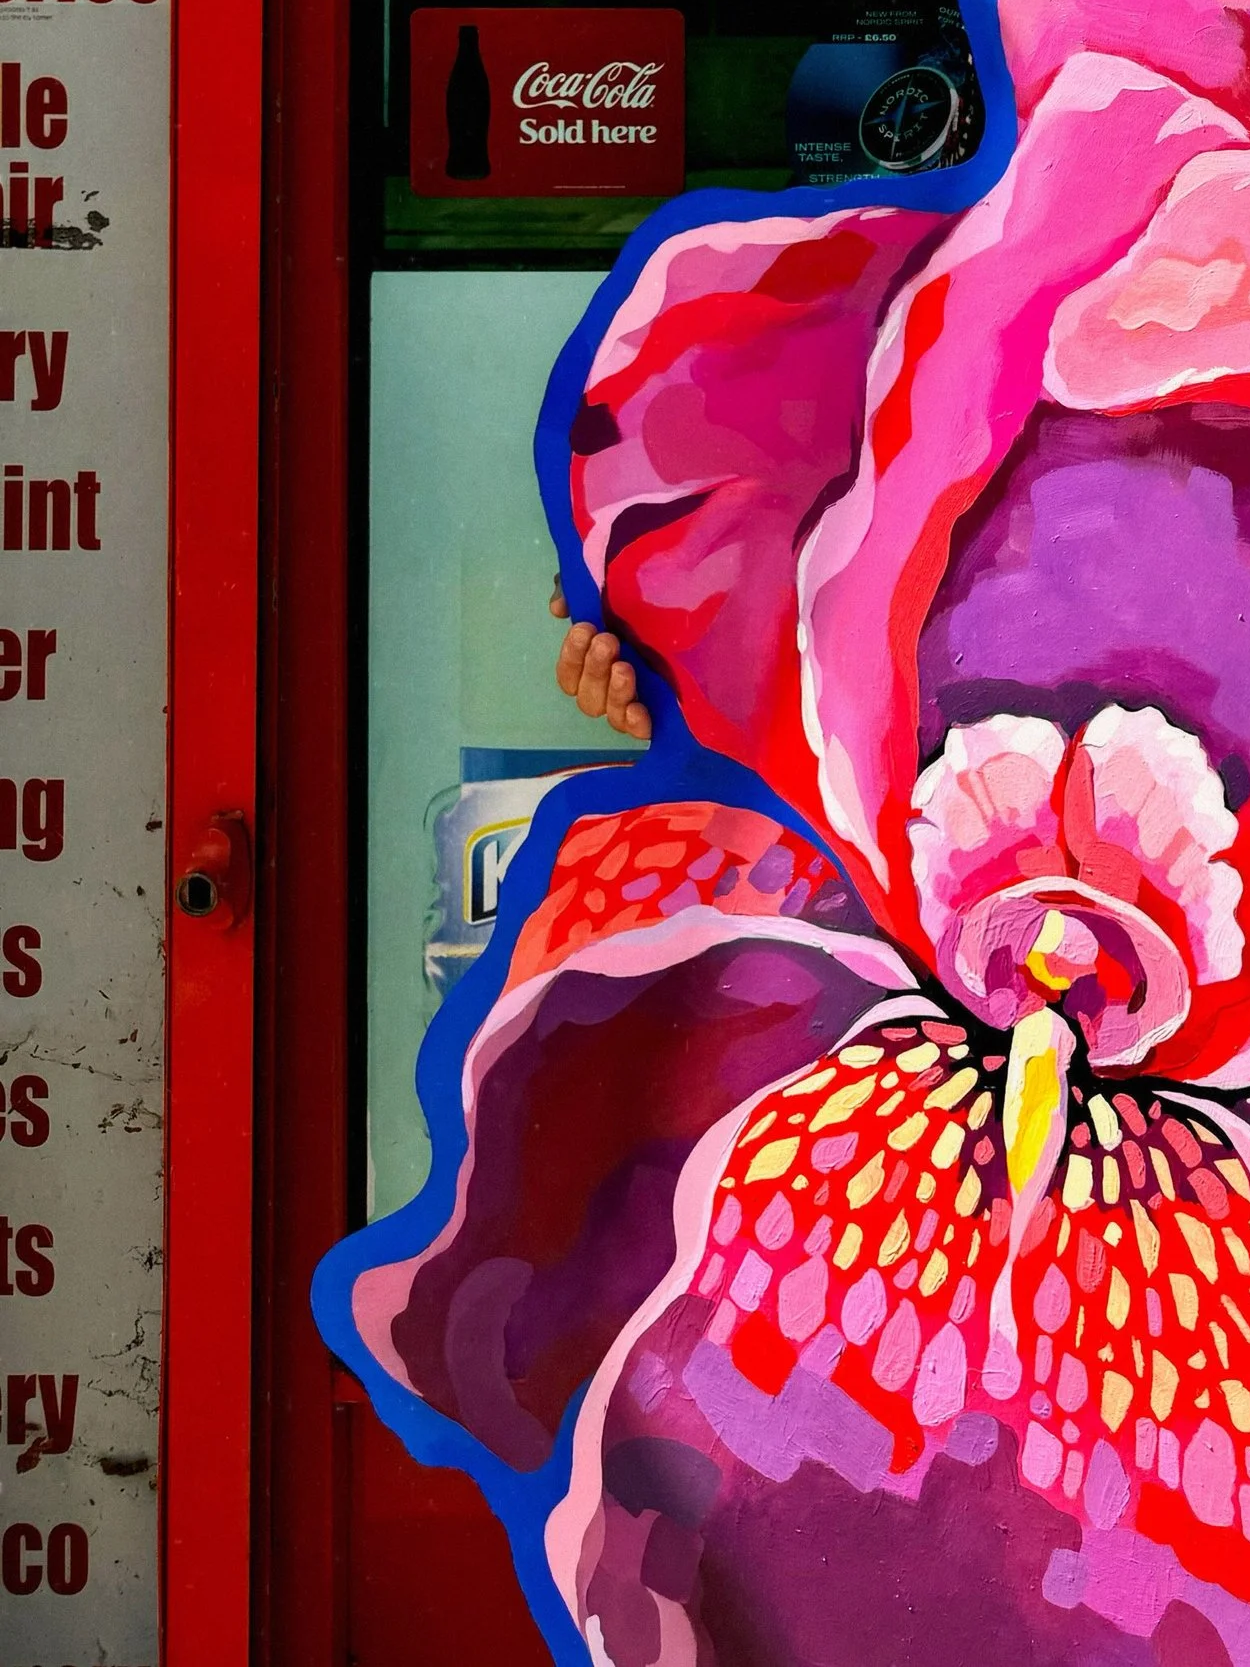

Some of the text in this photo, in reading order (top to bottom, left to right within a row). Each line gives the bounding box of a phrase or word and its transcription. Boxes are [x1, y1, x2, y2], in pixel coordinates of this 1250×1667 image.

[1, 62, 67, 150] le
[512, 61, 665, 109] Coca-Cola
[880, 87, 929, 116] NORDIC
[519, 118, 657, 145] Sold here
[795, 143, 851, 151] INTENSE
[0, 162, 63, 249] ir
[3, 465, 101, 551] int
[0, 1074, 49, 1147] s
[2, 1523, 89, 1596] co
